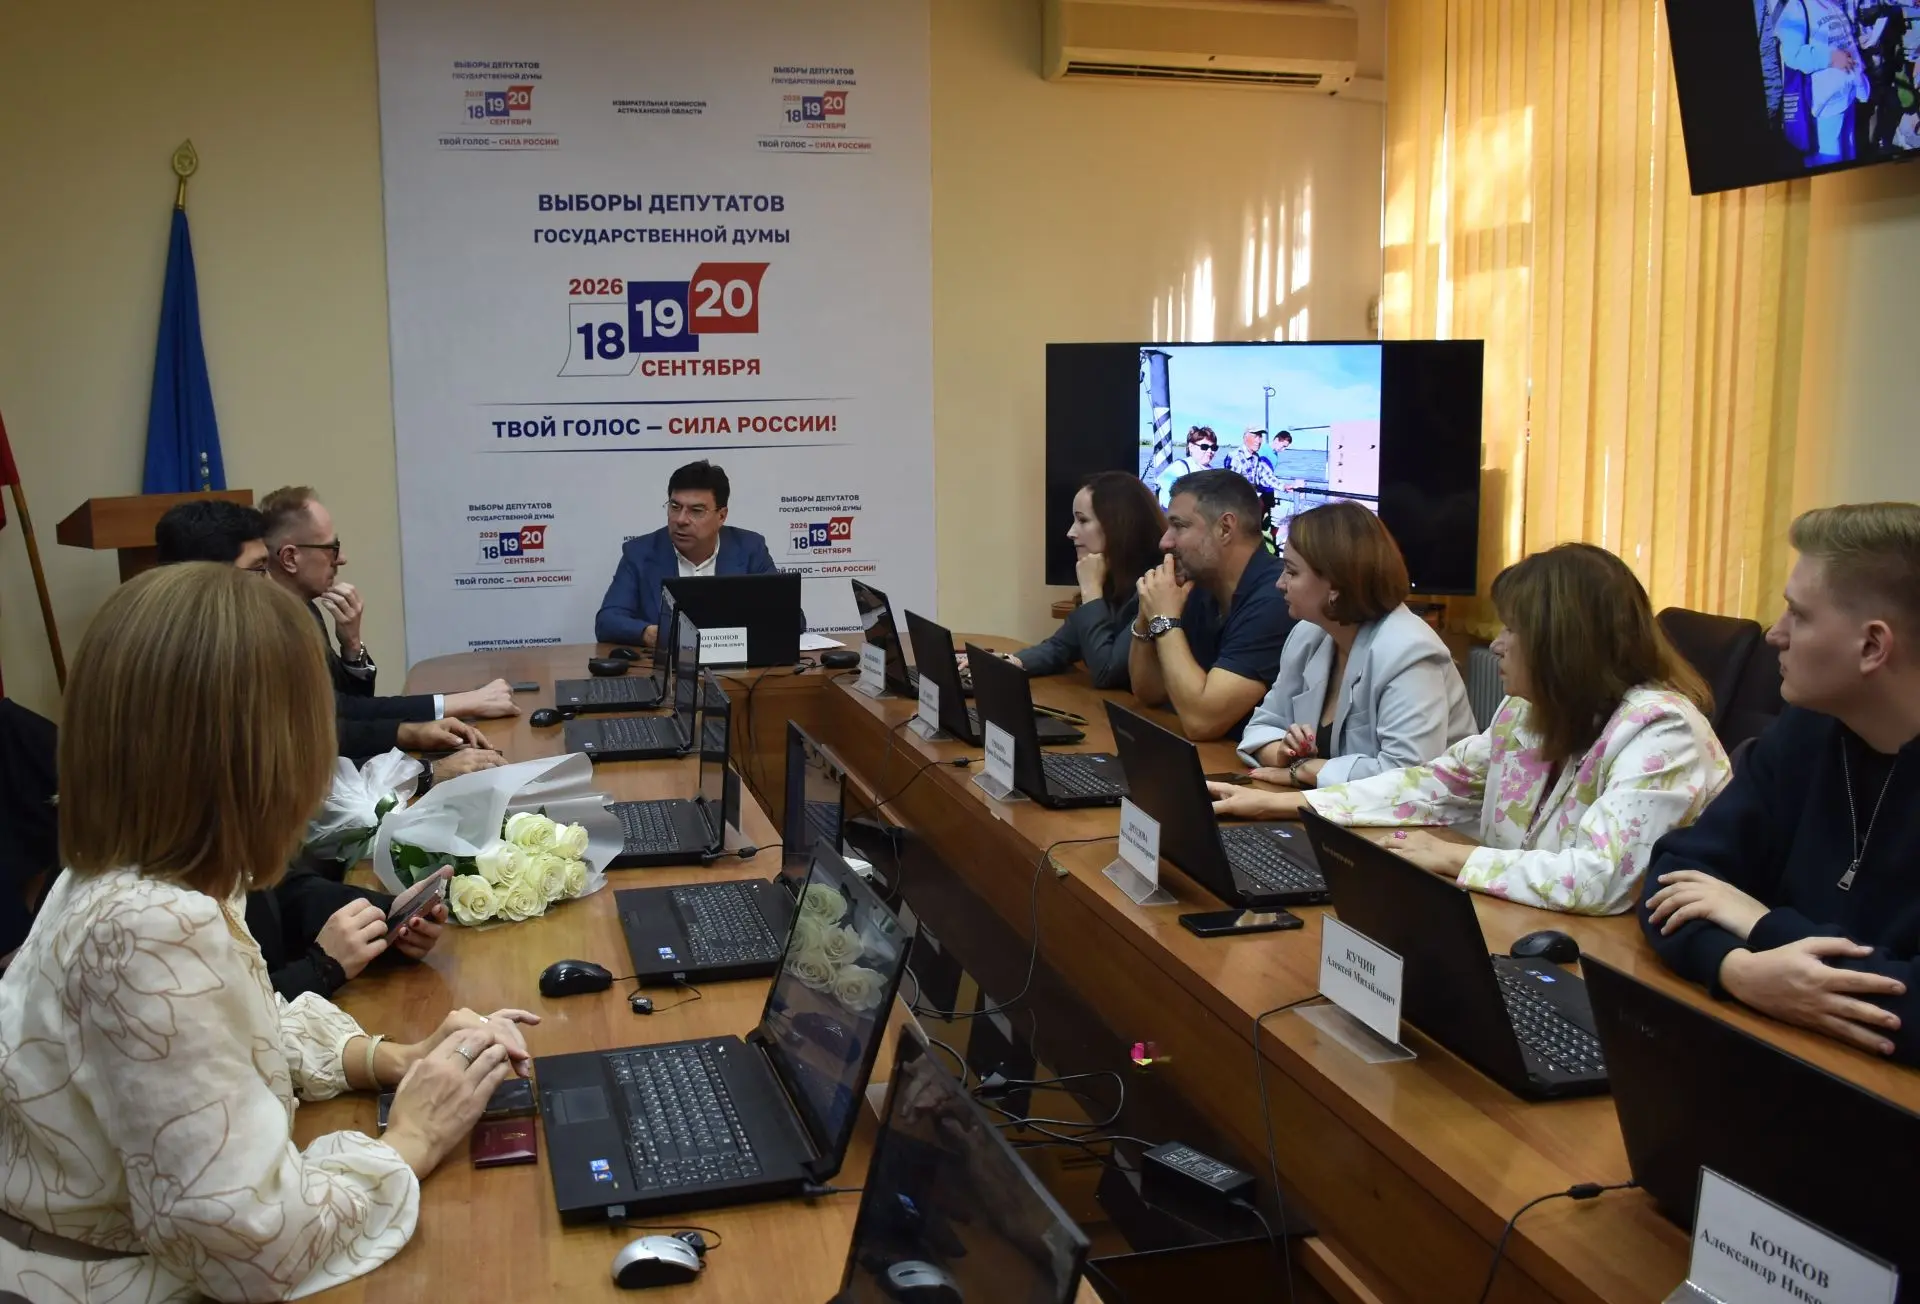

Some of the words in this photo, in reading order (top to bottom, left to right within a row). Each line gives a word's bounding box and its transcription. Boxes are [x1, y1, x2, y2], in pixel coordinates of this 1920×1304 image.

[454, 61, 490, 69] ВЫБОРЫ
[492, 61, 540, 69] ДЕПУТАТОВ
[809, 67, 854, 75] ДЕПУТАТОВ
[452, 72, 520, 80] ГОСУДАРСТВЕННОЙ
[467, 105, 485, 119] 18
[487, 98, 505, 112] 19
[508, 91, 529, 105] 20
[785, 109, 802, 122] 18
[804, 102, 821, 116] 19
[824, 96, 844, 110] 20
[489, 118, 532, 126] СЕНТЯБРЯ
[438, 137, 461, 145] ТВОЙ
[463, 138, 490, 146] ГОЛОС
[499, 138, 521, 146] СИЛА
[758, 140, 779, 148] ТВОЙ
[815, 141, 836, 149] СИЛА
[538, 194, 642, 212] ВЫБОРЫ
[649, 194, 785, 214] ДЕПУТАТОВ
[534, 225, 727, 245] ГОСУДАРСТВЕННОЙ
[732, 229, 790, 245] ДУМЫ
[568, 278, 624, 296] 2026
[577, 322, 625, 360] 18
[635, 299, 684, 338] 19
[695, 279, 753, 318] 20
[641, 358, 761, 377] СЕНТЯБРЯ
[492, 415, 556, 438] ТВОЙ
[563, 418, 641, 437] ГОЛОС
[668, 417, 732, 436] СИЛА
[738, 415, 837, 434] РОССИИ!
[505, 502, 552, 511] ДЕПУТАТОВ
[467, 514, 533, 522] ГОСУДАРСТВЕННОЙ
[534, 513, 555, 521] ДУМЫ
[792, 536, 808, 549] 18
[811, 528, 827, 542] 19
[830, 522, 849, 535] 20
[482, 546, 499, 559] 18
[501, 538, 518, 552] 19
[521, 531, 542, 545] 20
[812, 547, 852, 555] СЕНТЯБРЯ
[503, 557, 545, 565] СЕНТЯБРЯ
[821, 565, 841, 573] СИЛА
[455, 577, 476, 585] ТВОЙ
[478, 577, 505, 585] ГОЛОС
[513, 576, 535, 584] СИЛА
[536, 575, 572, 583] РОССИИ!
[468, 639, 522, 647] ИЗБИРАТЕЛЬНАЯ
[1346, 948, 1376, 977] КУЧИН
[1326, 956, 1352, 978] Алексей
[1354, 971, 1396, 1006] Михайлович
[1700, 1228, 1777, 1284] Александр
[1750, 1231, 1829, 1288] КОЧКОВ
